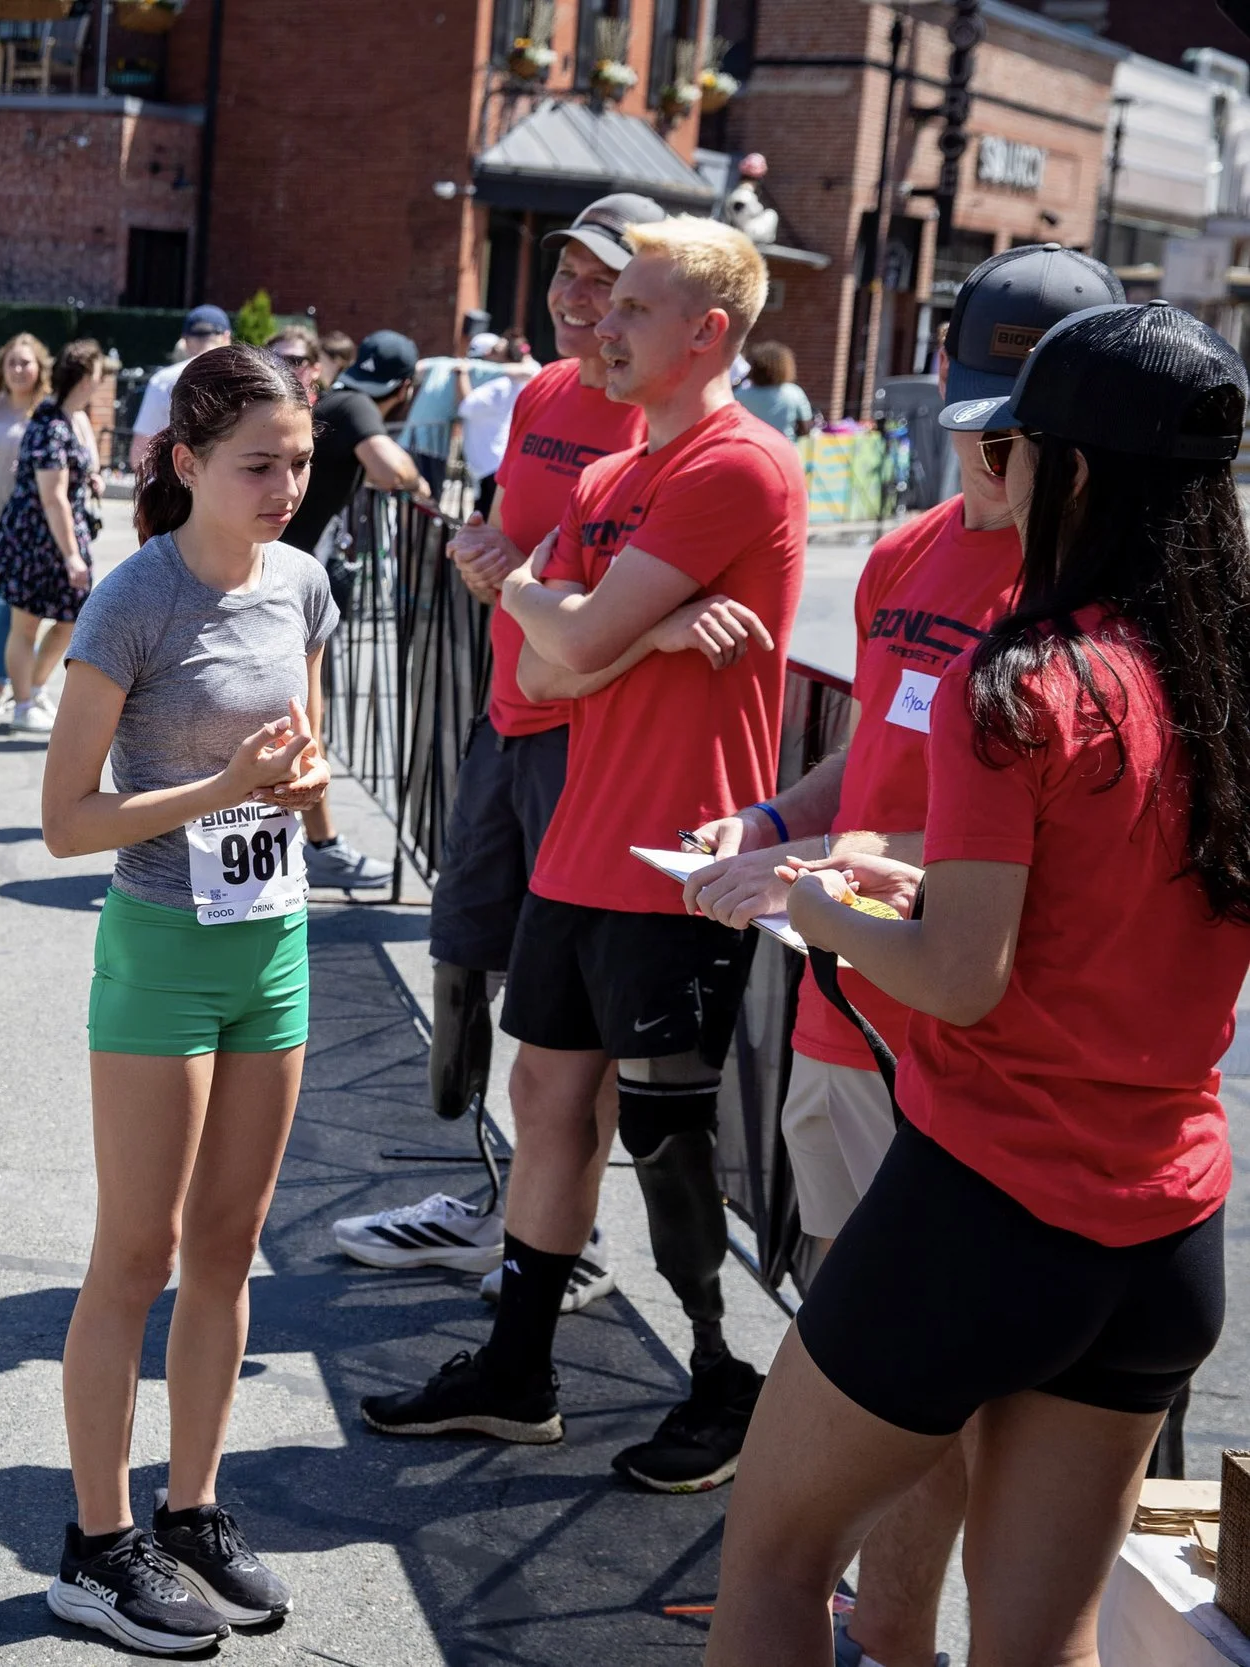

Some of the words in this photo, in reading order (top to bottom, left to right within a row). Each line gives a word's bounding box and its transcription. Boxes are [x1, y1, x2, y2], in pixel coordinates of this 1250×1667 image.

[997, 331, 1039, 347] BION
[201, 805, 283, 828] BIONIC
[221, 828, 288, 885] 981
[207, 908, 235, 919] FOOD
[251, 902, 275, 913] DRINK
[284, 897, 301, 907] DRINK
[74, 1570, 119, 1609] HOKA
